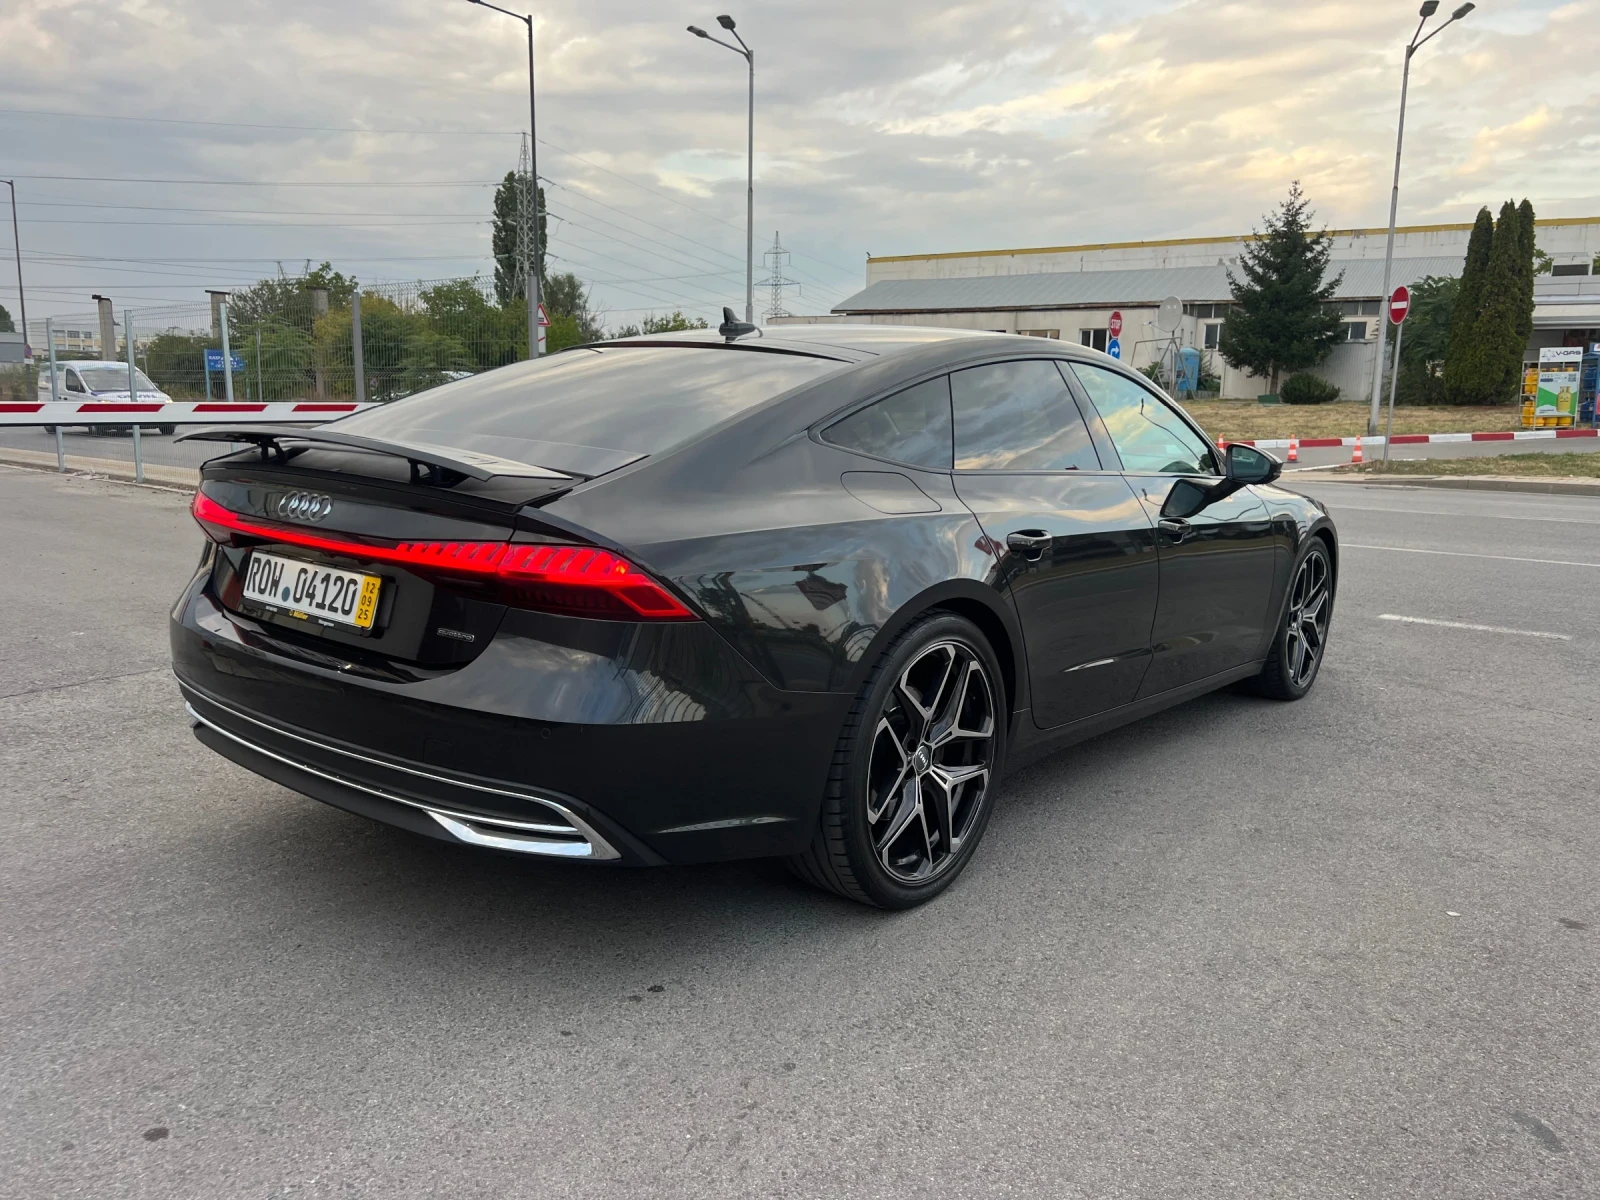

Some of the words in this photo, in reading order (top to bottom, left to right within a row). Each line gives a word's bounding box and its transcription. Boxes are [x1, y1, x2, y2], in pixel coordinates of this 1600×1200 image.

[1111, 319, 1121, 329] STOP
[246, 556, 285, 598] ROW
[292, 567, 358, 616] 04120
[365, 581, 376, 594] 12
[361, 595, 372, 607] 09
[357, 608, 369, 620] 25
